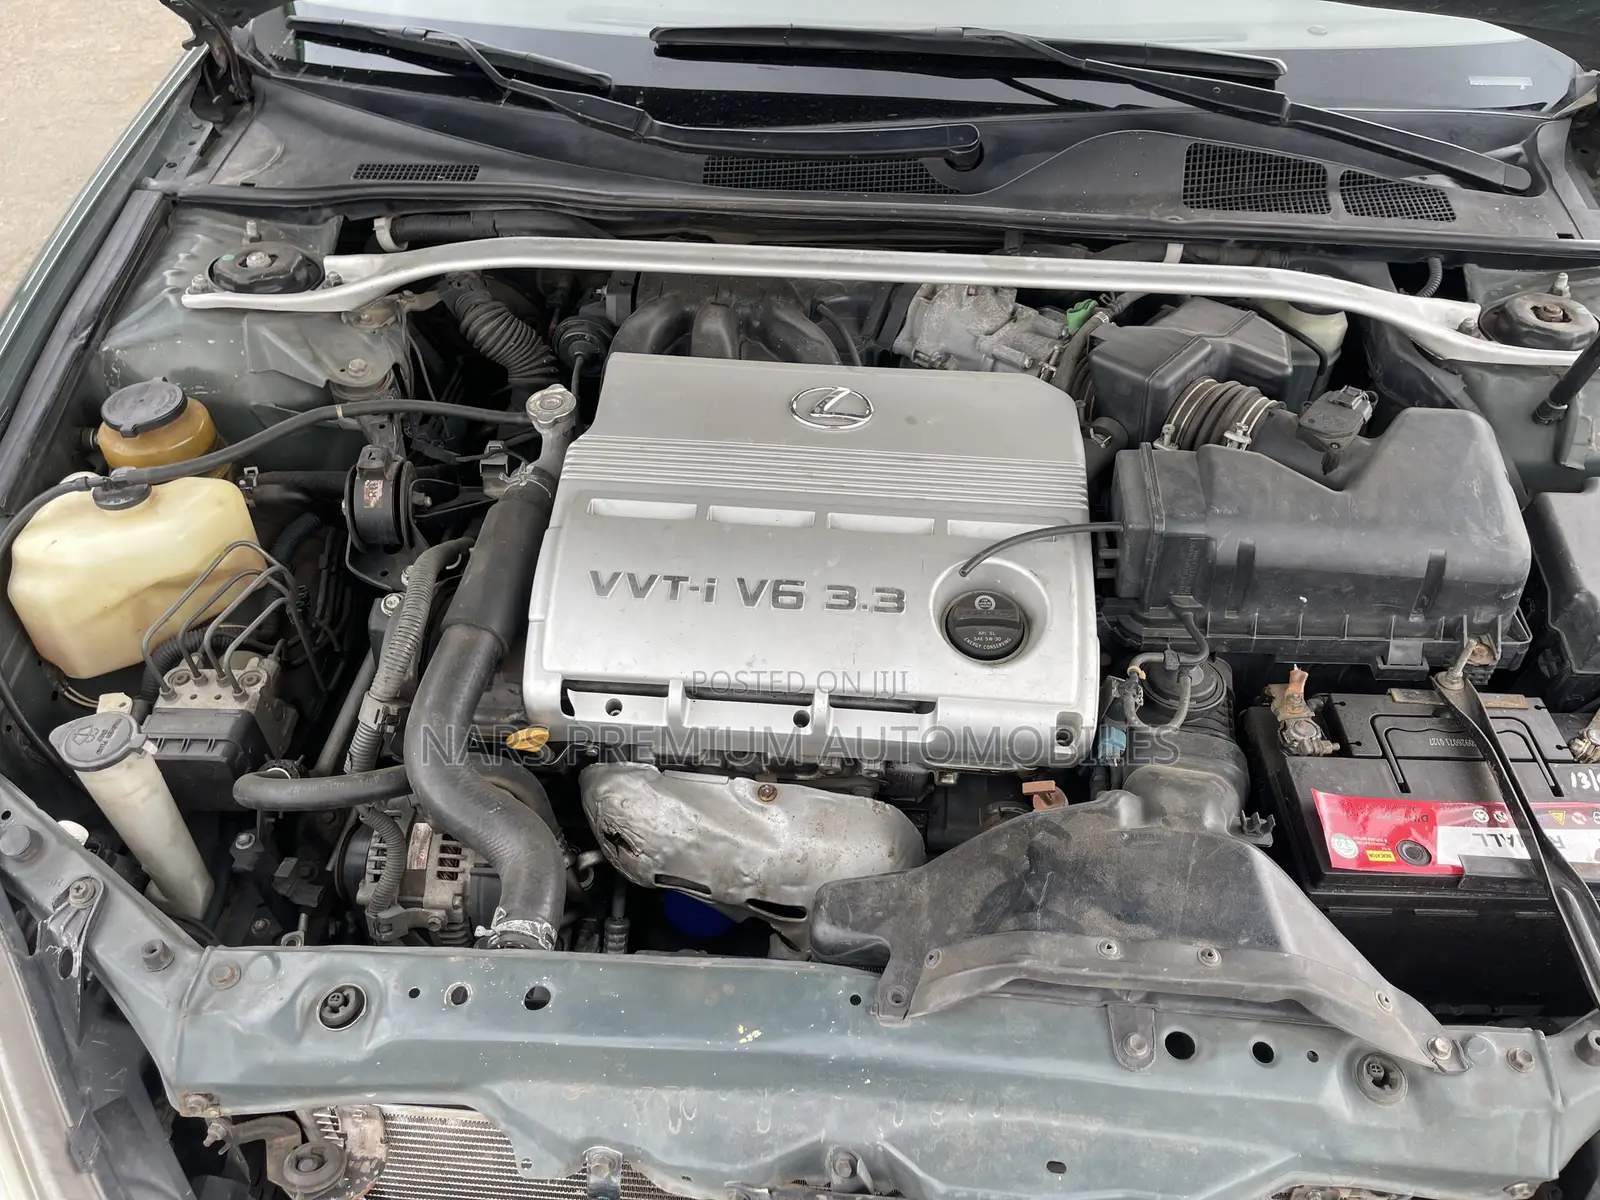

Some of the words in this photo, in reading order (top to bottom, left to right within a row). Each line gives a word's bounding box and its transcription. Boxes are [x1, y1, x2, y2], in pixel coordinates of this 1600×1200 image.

[589, 570, 719, 605] VVT-i
[734, 576, 807, 611] V6
[824, 584, 907, 615] 3.3
